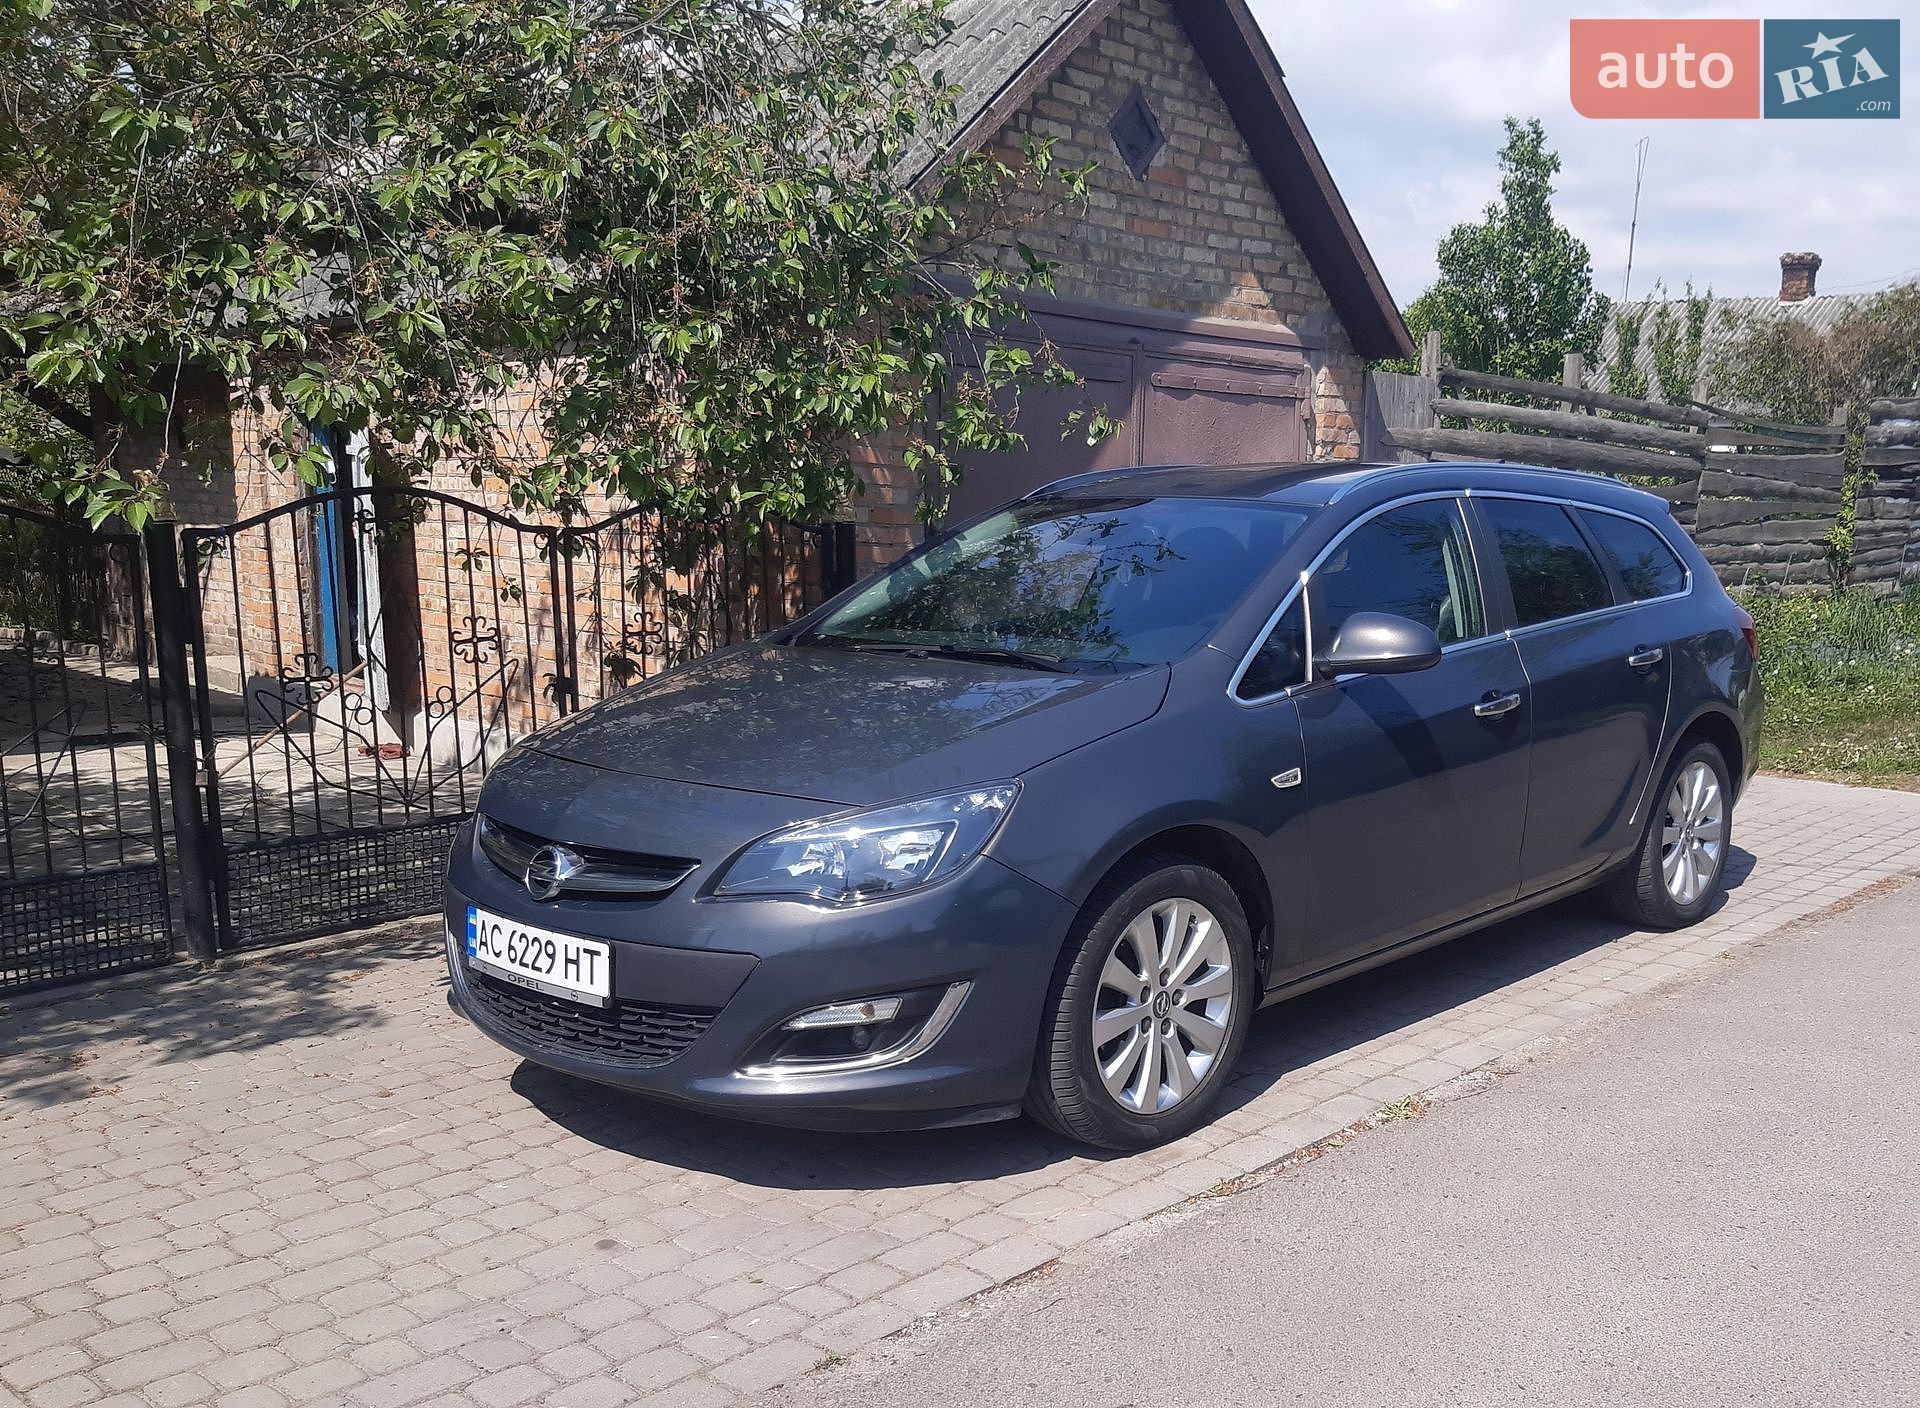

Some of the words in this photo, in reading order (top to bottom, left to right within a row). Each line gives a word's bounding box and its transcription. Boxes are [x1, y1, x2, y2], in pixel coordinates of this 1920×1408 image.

[478, 919, 503, 958] AC
[507, 930, 557, 974] 6229
[564, 943, 601, 985] HT
[507, 973, 545, 992] OPEL
